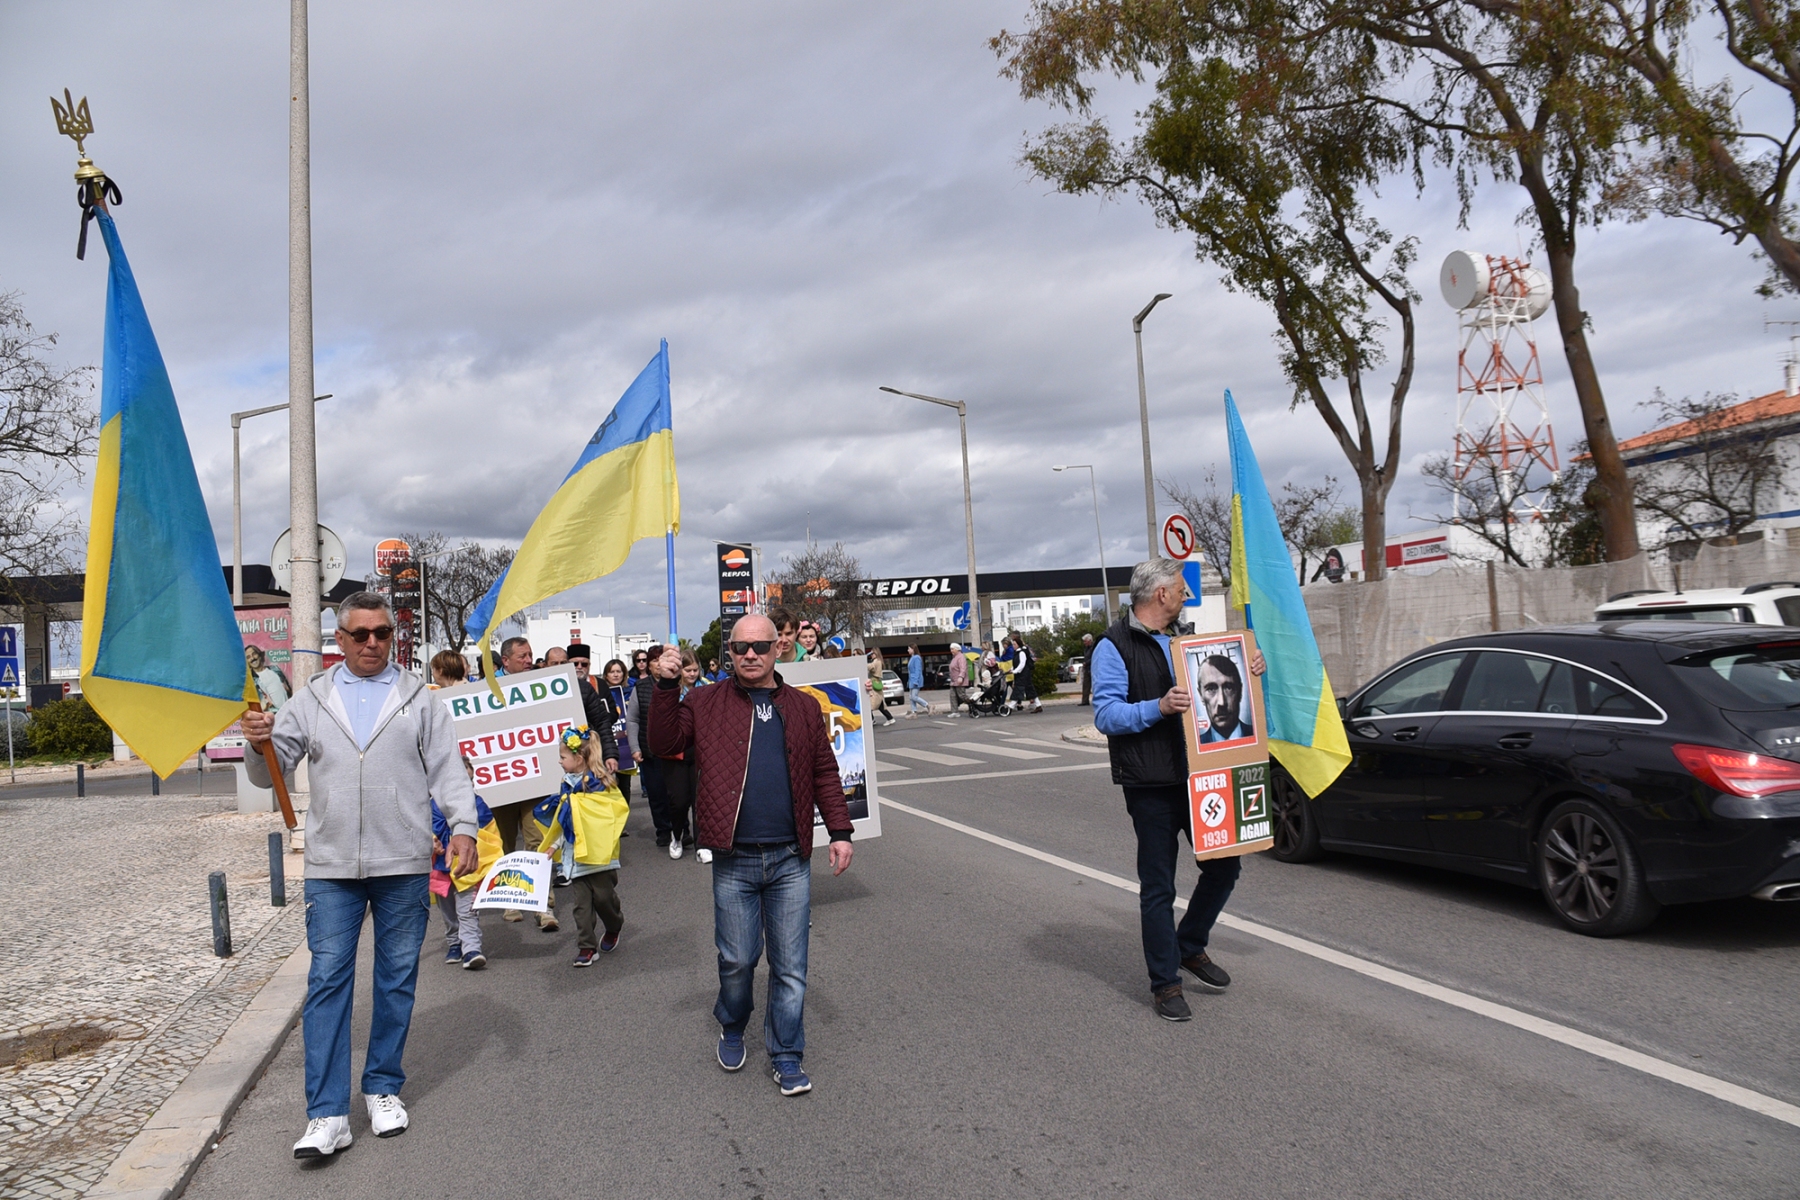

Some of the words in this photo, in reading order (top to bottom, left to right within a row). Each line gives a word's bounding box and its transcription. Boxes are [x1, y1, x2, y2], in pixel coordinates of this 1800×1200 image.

[857, 578, 952, 597] REPSOL
[237, 619, 261, 634] INHA
[452, 678, 569, 717] RIGADO
[458, 722, 572, 758] RTUGU
[826, 710, 846, 756] 5
[475, 756, 541, 785] SES!
[1238, 766, 1265, 785] 2022
[1194, 773, 1228, 793] NEVER
[1202, 829, 1229, 848] 1939
[1240, 820, 1271, 841] AGAIN
